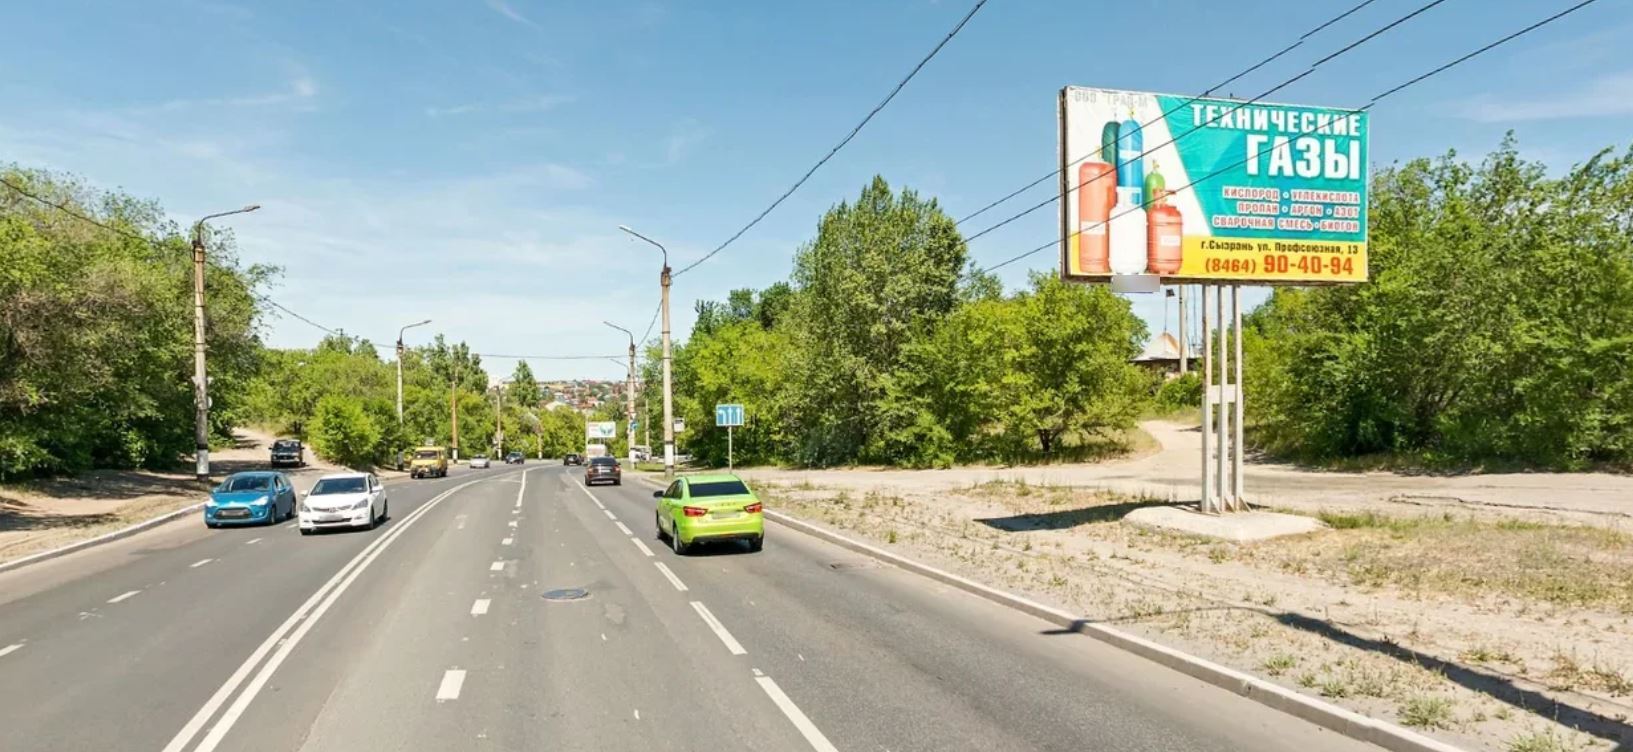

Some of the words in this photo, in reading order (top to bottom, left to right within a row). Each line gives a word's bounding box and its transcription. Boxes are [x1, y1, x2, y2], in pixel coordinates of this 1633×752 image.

[1191, 103, 1361, 137] ТЕХНИЧЕСКИЕ
[1246, 134, 1361, 180] ГАЗЫ
[1223, 187, 1280, 201] КИСЛОРОД
[1291, 190, 1360, 203] УГЛЕКИСЛОТА
[1237, 202, 1279, 214] ПРОПАН
[1291, 204, 1323, 216] АРГОН
[1334, 206, 1359, 218] АЗОТ
[1213, 215, 1275, 229] СВАРОЧНАЯ
[1278, 218, 1313, 230] СМЕСЬ
[1257, 242, 1271, 253] ул.
[1275, 242, 1344, 255] Профсоюзная,
[1347, 245, 1359, 255] 13
[1205, 258, 1256, 274] (8464)
[1263, 254, 1354, 275] 90-40-94
